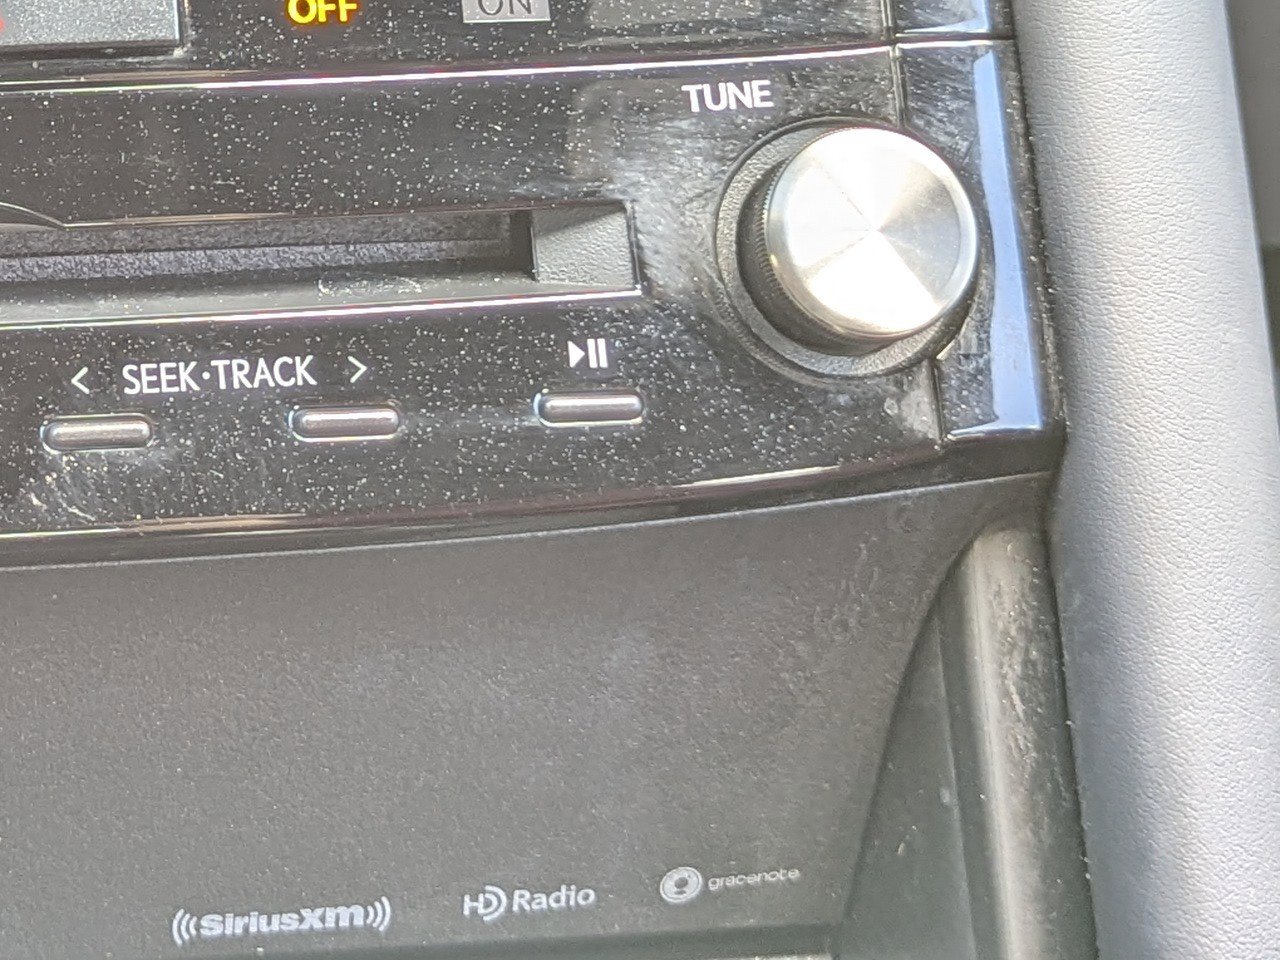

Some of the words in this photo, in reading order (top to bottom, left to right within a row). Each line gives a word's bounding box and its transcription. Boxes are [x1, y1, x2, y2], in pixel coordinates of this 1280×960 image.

[681, 79, 774, 113] TUNE
[708, 868, 801, 891] gracenote
[512, 884, 596, 913] Radio
